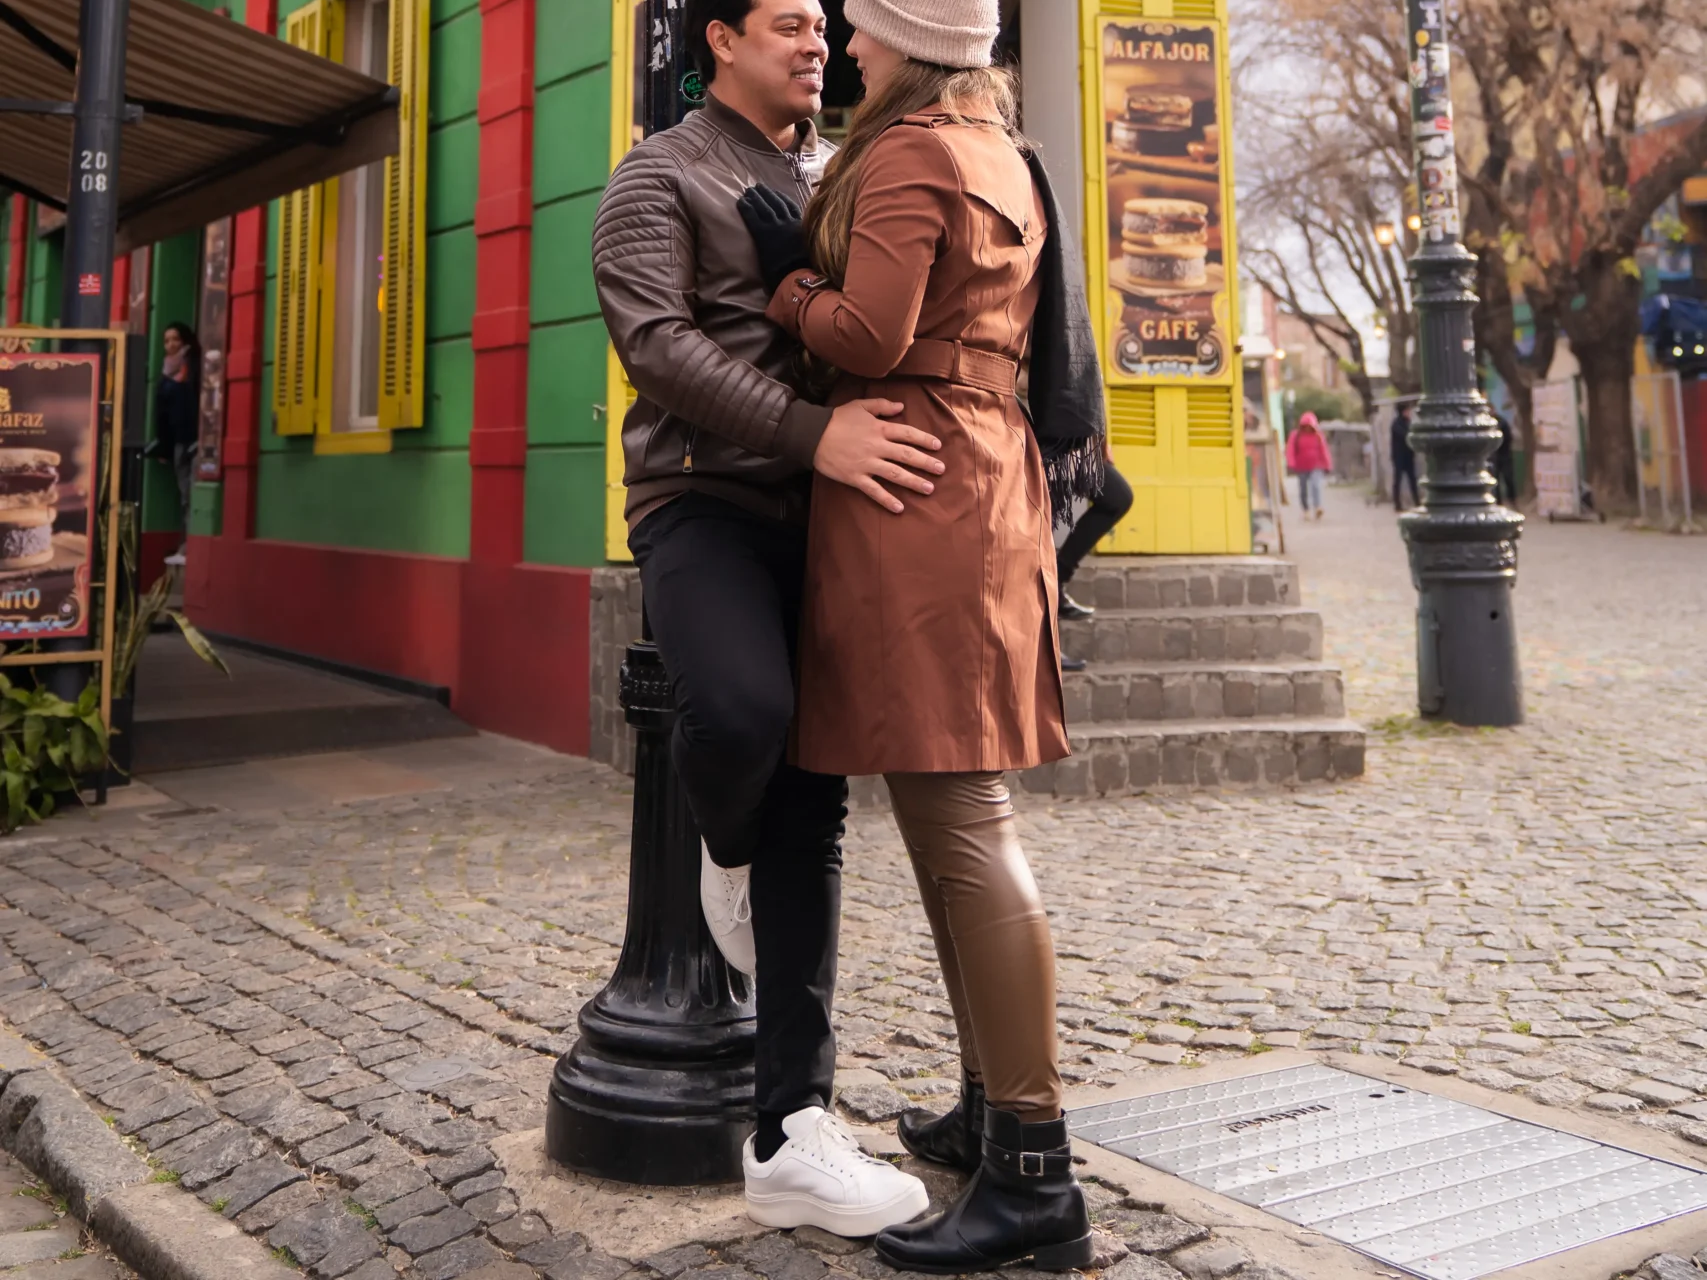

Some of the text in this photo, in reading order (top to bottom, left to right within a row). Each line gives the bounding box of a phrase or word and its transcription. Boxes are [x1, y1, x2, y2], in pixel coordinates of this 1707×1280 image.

[1112, 40, 1210, 61] ALFAJOR
[80, 150, 107, 170] 20
[81, 173, 107, 192] 08
[1140, 319, 1199, 340] CAFE
